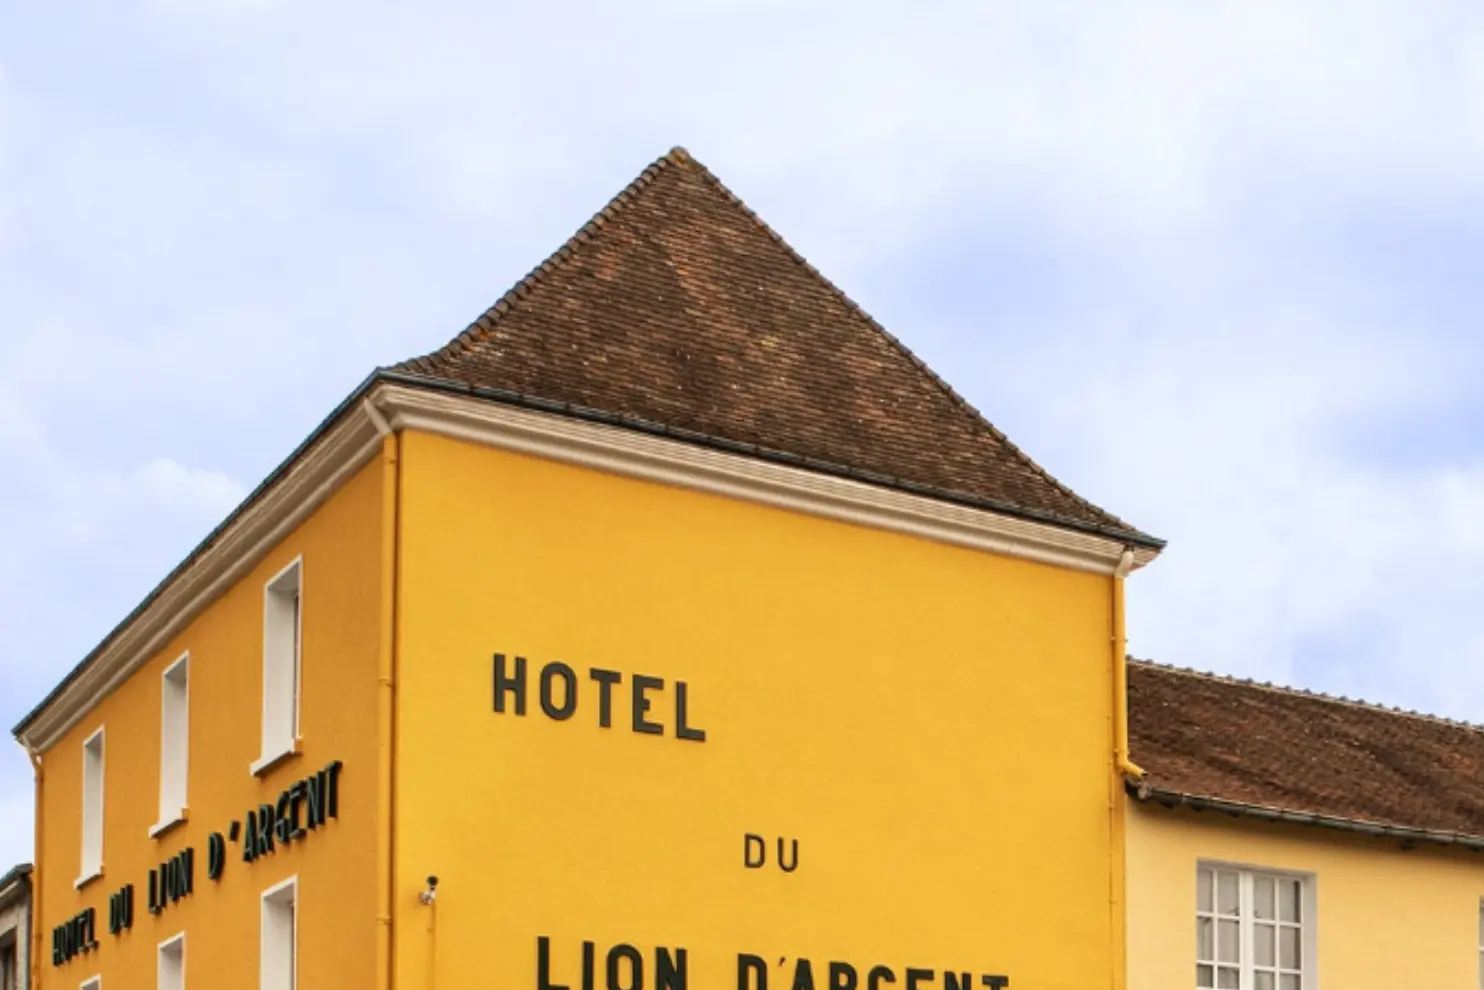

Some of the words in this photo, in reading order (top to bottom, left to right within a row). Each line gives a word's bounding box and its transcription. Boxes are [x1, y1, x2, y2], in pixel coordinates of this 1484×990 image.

[492, 653, 706, 743] HOTEL
[52, 906, 99, 967] HOTEL
[109, 883, 134, 935] DU
[148, 847, 194, 915] LION
[208, 760, 343, 881] D'ARGENT
[743, 833, 799, 873] DU
